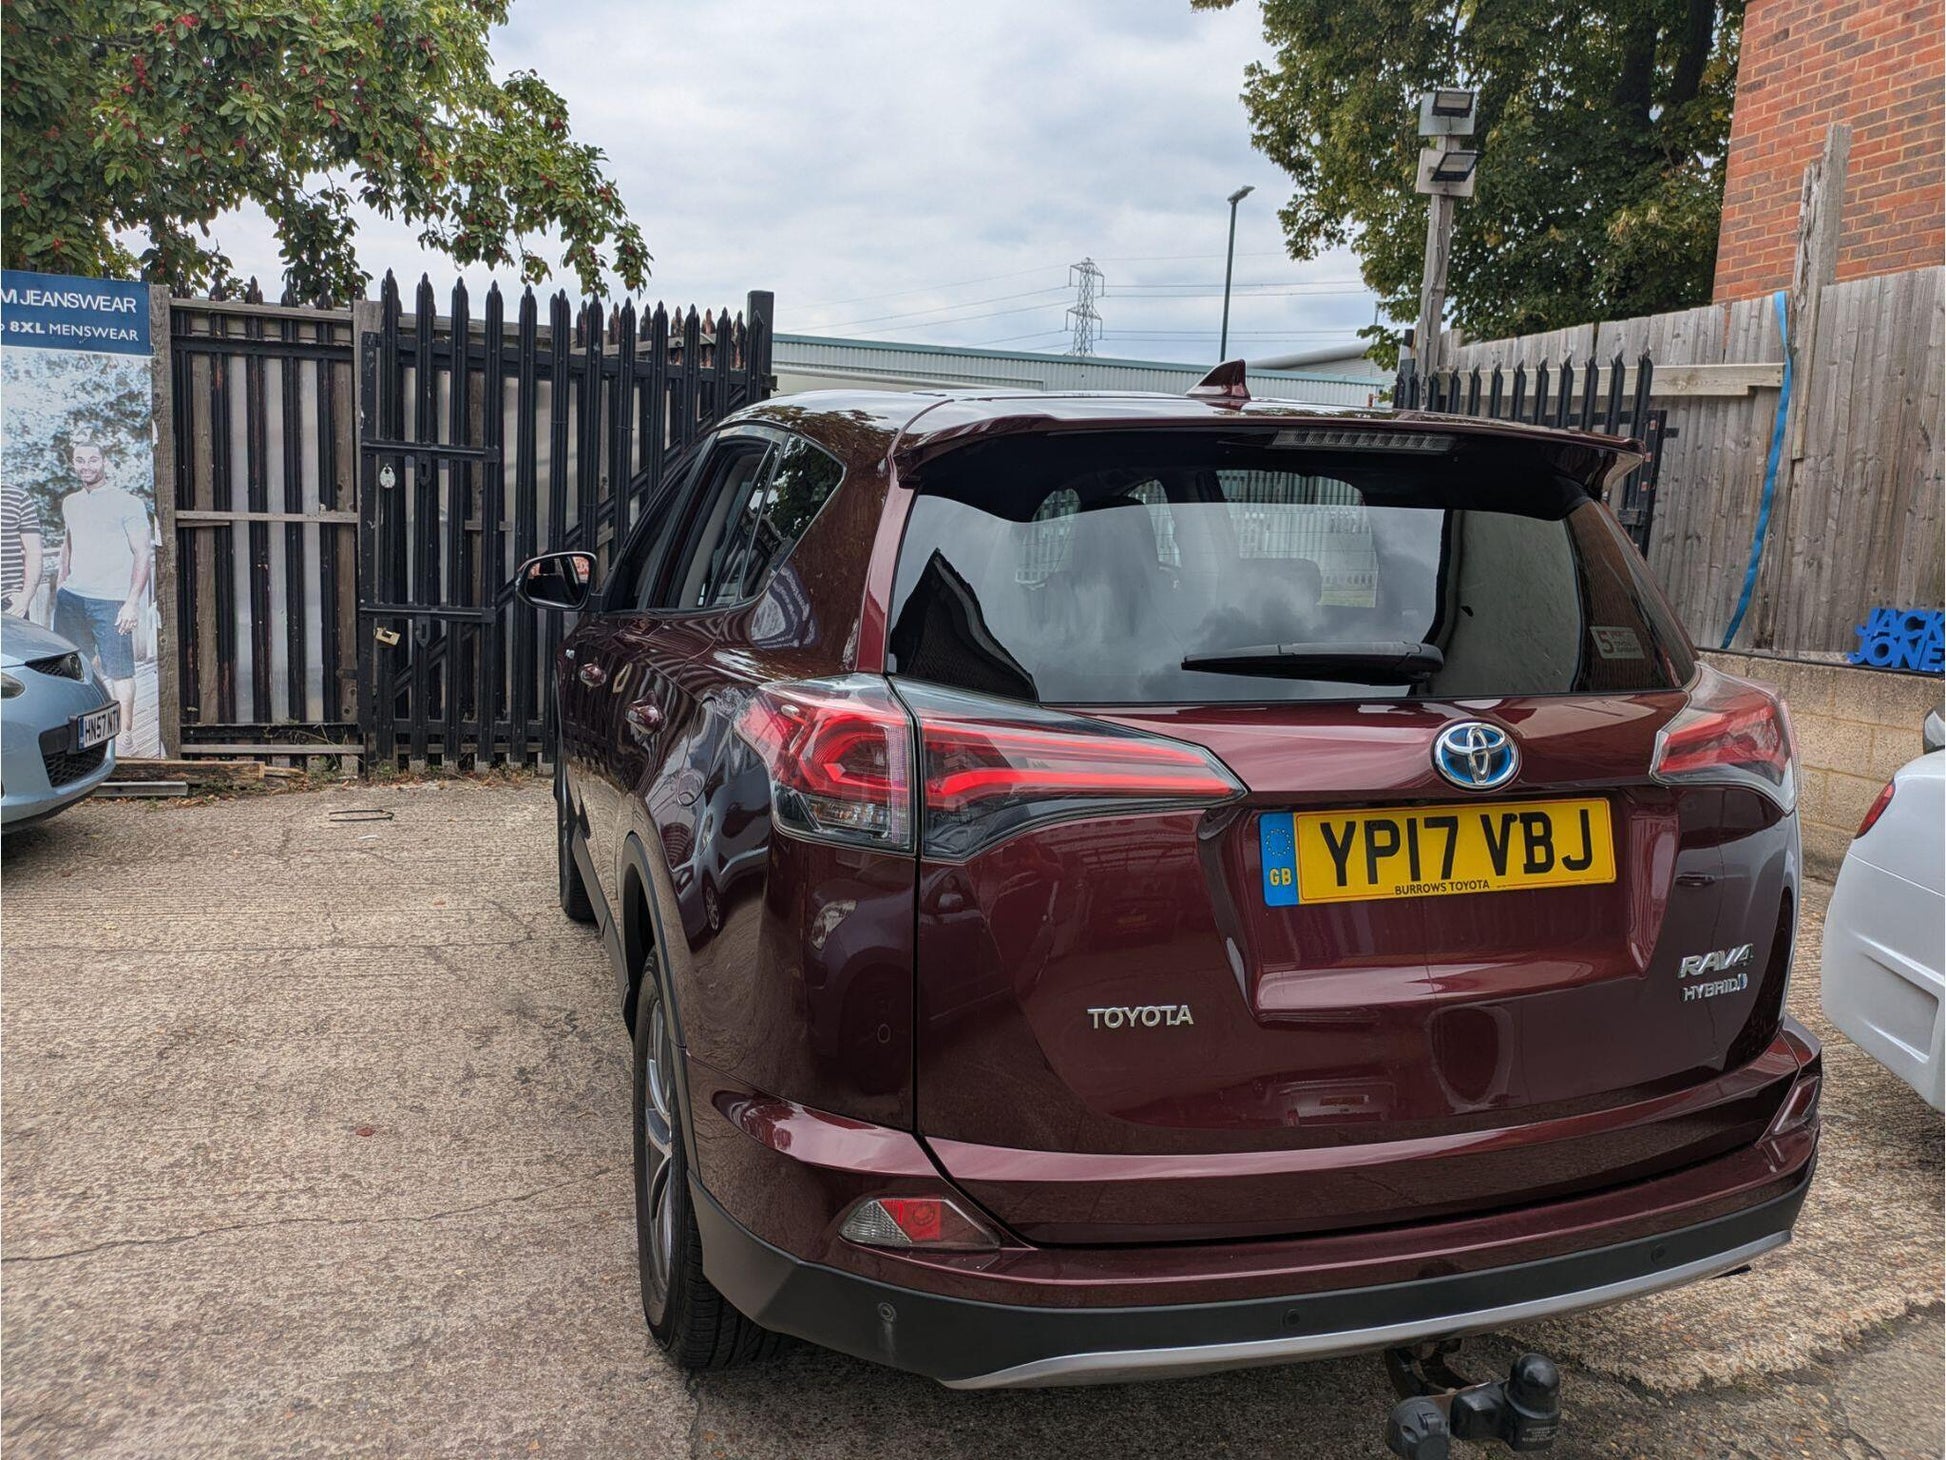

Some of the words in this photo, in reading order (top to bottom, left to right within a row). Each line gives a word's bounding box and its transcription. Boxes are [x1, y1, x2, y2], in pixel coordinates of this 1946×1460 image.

[20, 289, 137, 313] JEANSWEAR
[10, 321, 45, 334] 8XL
[49, 323, 139, 341] MENSWEAR
[1856, 607, 1945, 641] JACK
[85, 714, 106, 743] HN57
[1320, 815, 1459, 887] YP17
[1480, 808, 1594, 877] VBJ
[1270, 867, 1292, 886] GB
[1395, 882, 1447, 896] BURROWS
[1449, 879, 1490, 892] TOYOTA
[1678, 943, 1753, 978] RAV4
[1683, 977, 1740, 1002] HYBRID
[1087, 1005, 1194, 1029] TOYOTA
